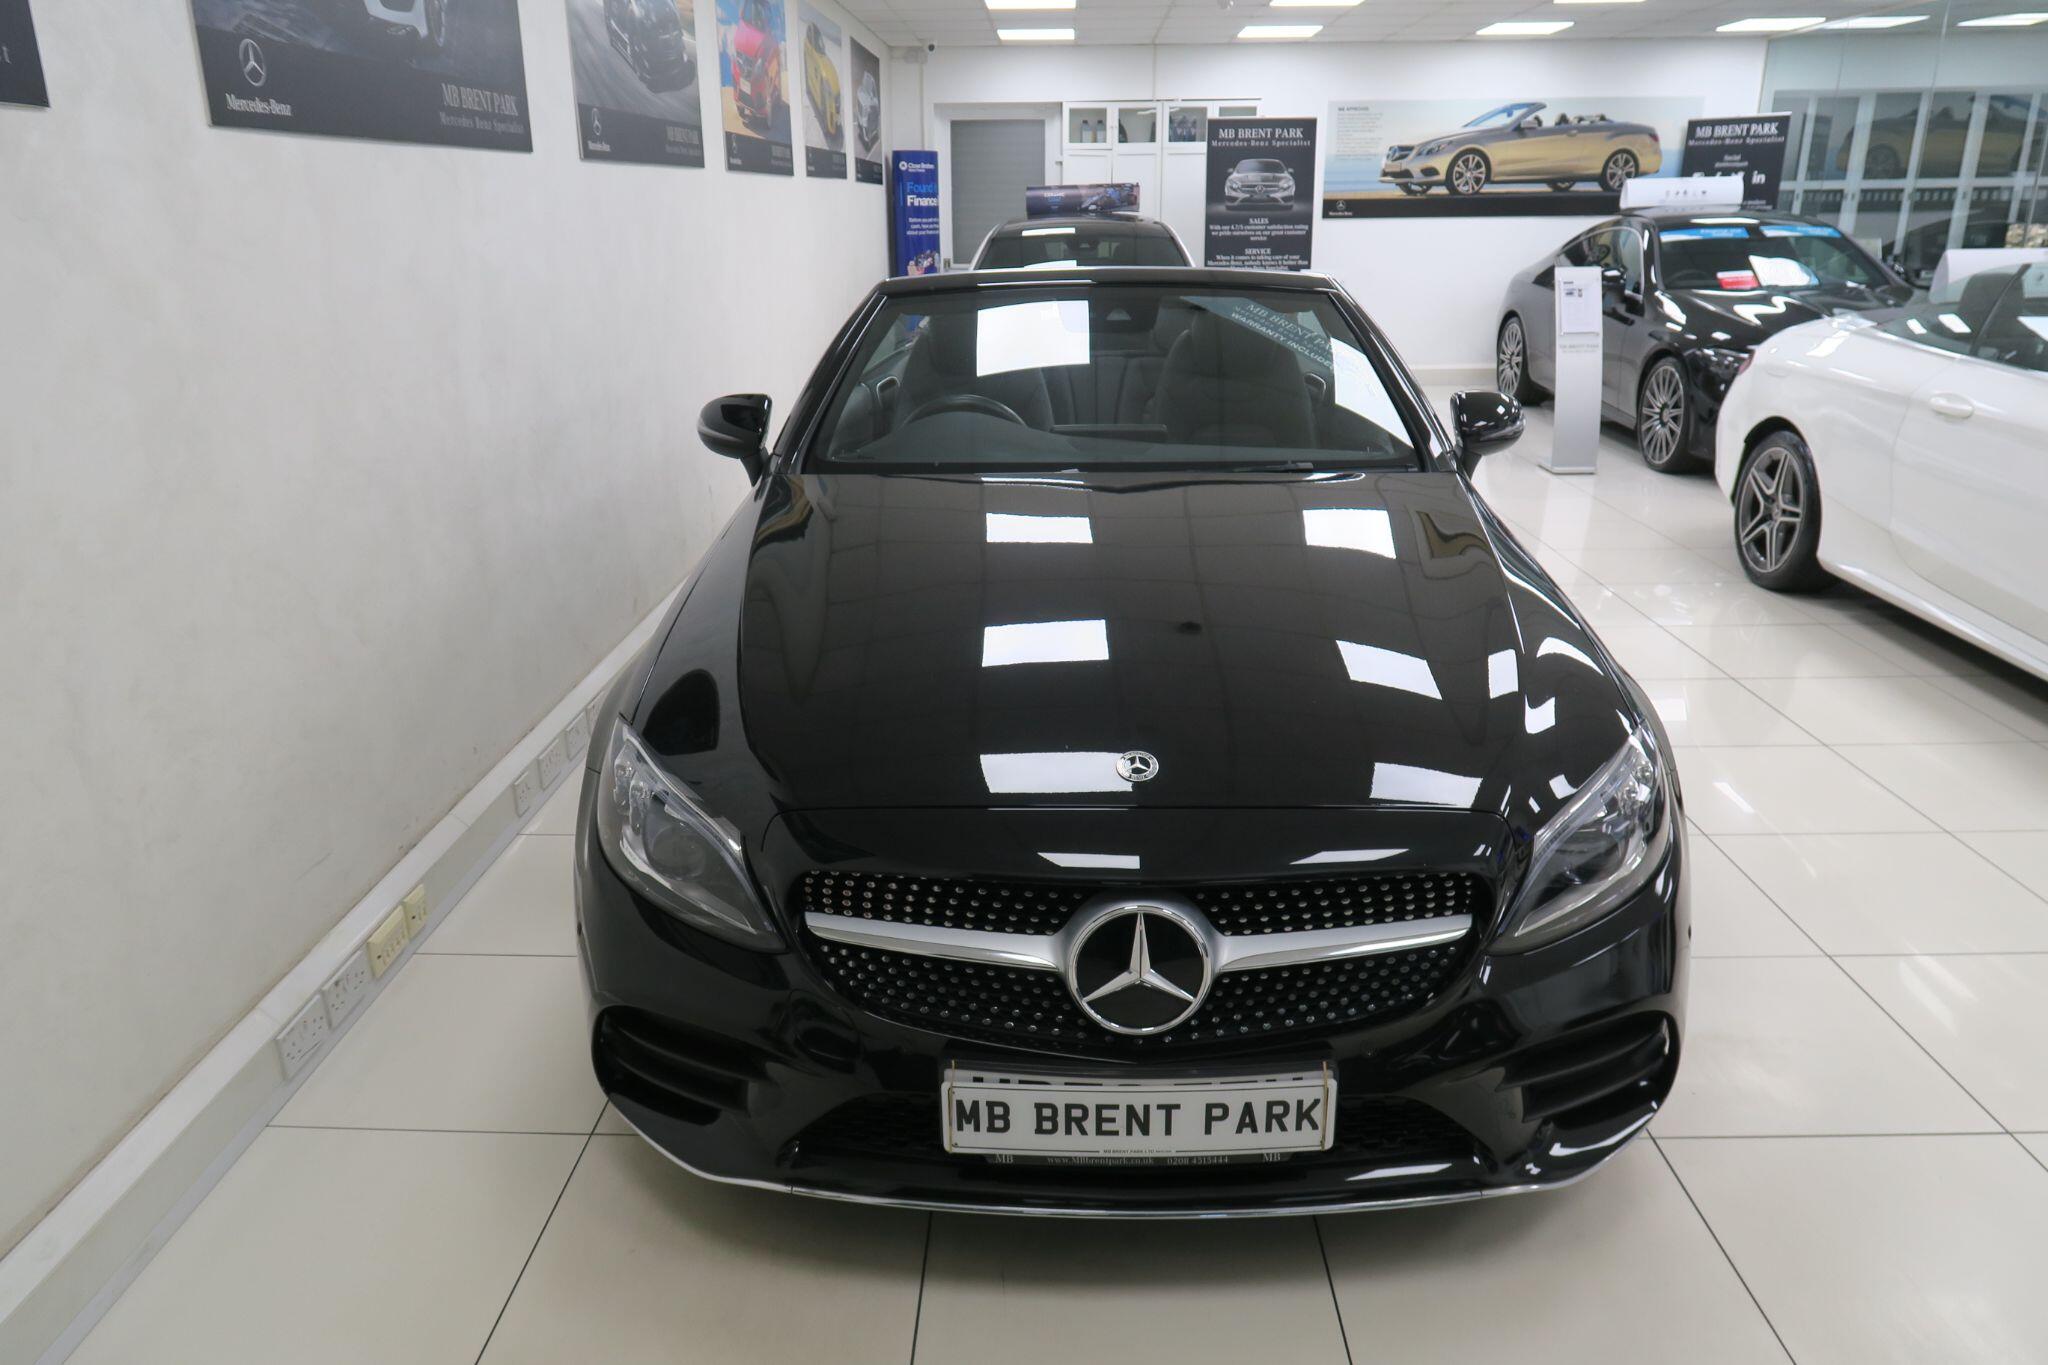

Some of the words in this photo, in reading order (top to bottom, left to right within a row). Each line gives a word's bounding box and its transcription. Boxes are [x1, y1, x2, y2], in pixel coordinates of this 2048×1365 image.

[225, 92, 293, 116] Mercedes-Benz
[441, 83, 460, 108] MB
[460, 86, 492, 112] BRENT
[493, 92, 519, 116] PARK
[1218, 128, 1236, 139] MB
[1238, 128, 1273, 139] BRENT
[1275, 127, 1304, 139] PARK
[1694, 125, 1713, 139] MB
[1713, 123, 1749, 138] BRENT
[1750, 122, 1779, 136] PARK
[1271, 140, 1311, 148] Specialist
[1249, 217, 1269, 225] SALES
[1246, 304, 1269, 319] MB
[1269, 314, 1317, 339] BRENT
[1231, 312, 1287, 343] WARRANTY
[1286, 341, 1335, 370] INCLUDE
[955, 1099, 1011, 1133] MB
[1034, 1101, 1181, 1137] BRENT
[1204, 1098, 1321, 1135] PARK
[994, 1154, 1014, 1164] MB
[1262, 1152, 1281, 1162] MB
